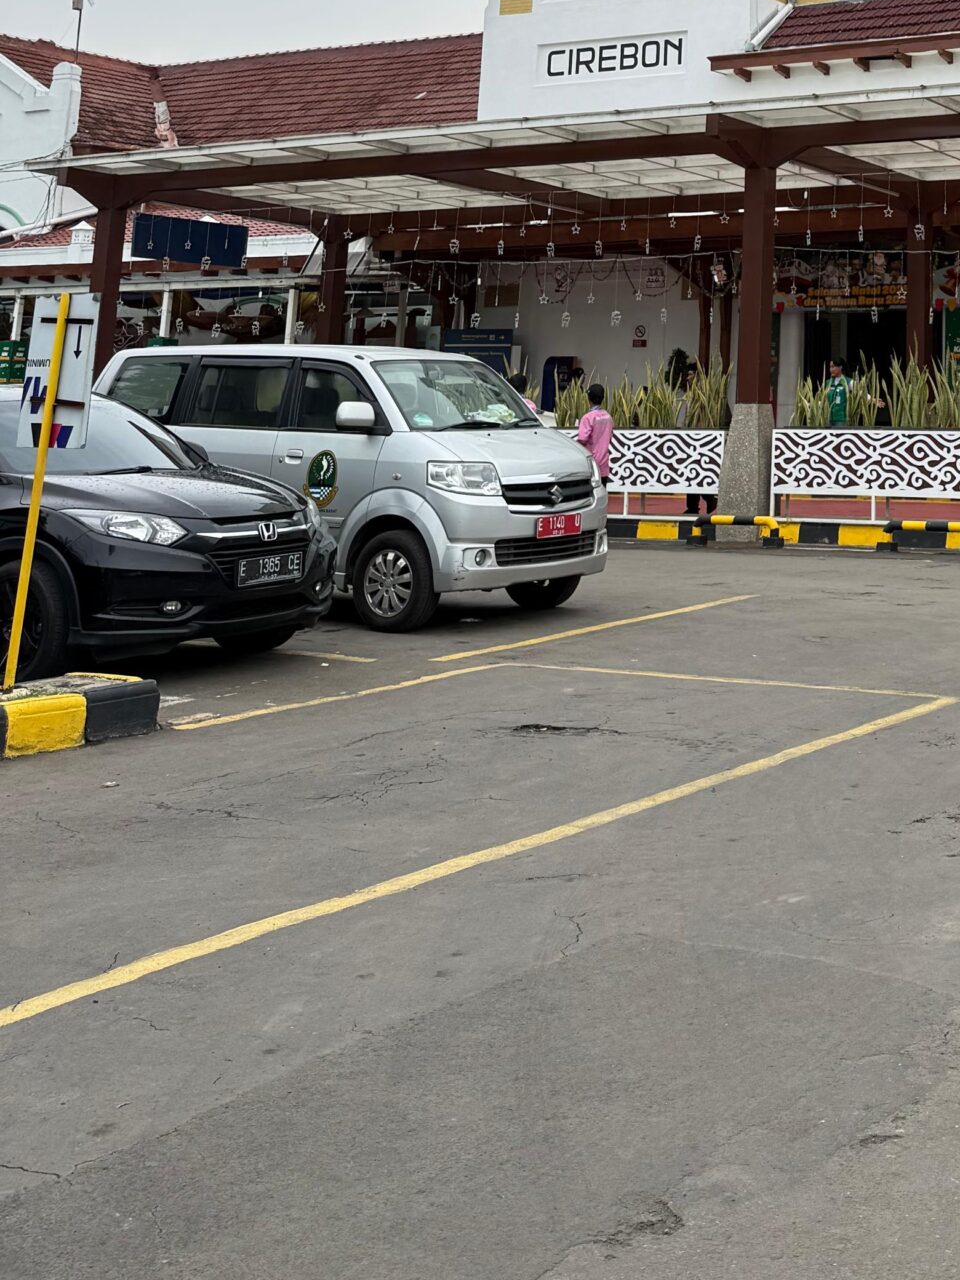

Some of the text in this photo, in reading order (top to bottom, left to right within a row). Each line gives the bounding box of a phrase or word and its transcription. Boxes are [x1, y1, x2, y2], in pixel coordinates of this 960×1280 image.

[547, 38, 683, 77] CIREBON
[825, 297, 858, 306] Tahun
[858, 296, 885, 305] Baru
[538, 513, 581, 531] E 1140 U
[240, 561, 247, 577] E
[259, 556, 281, 575] 1365
[288, 554, 301, 570] CE
